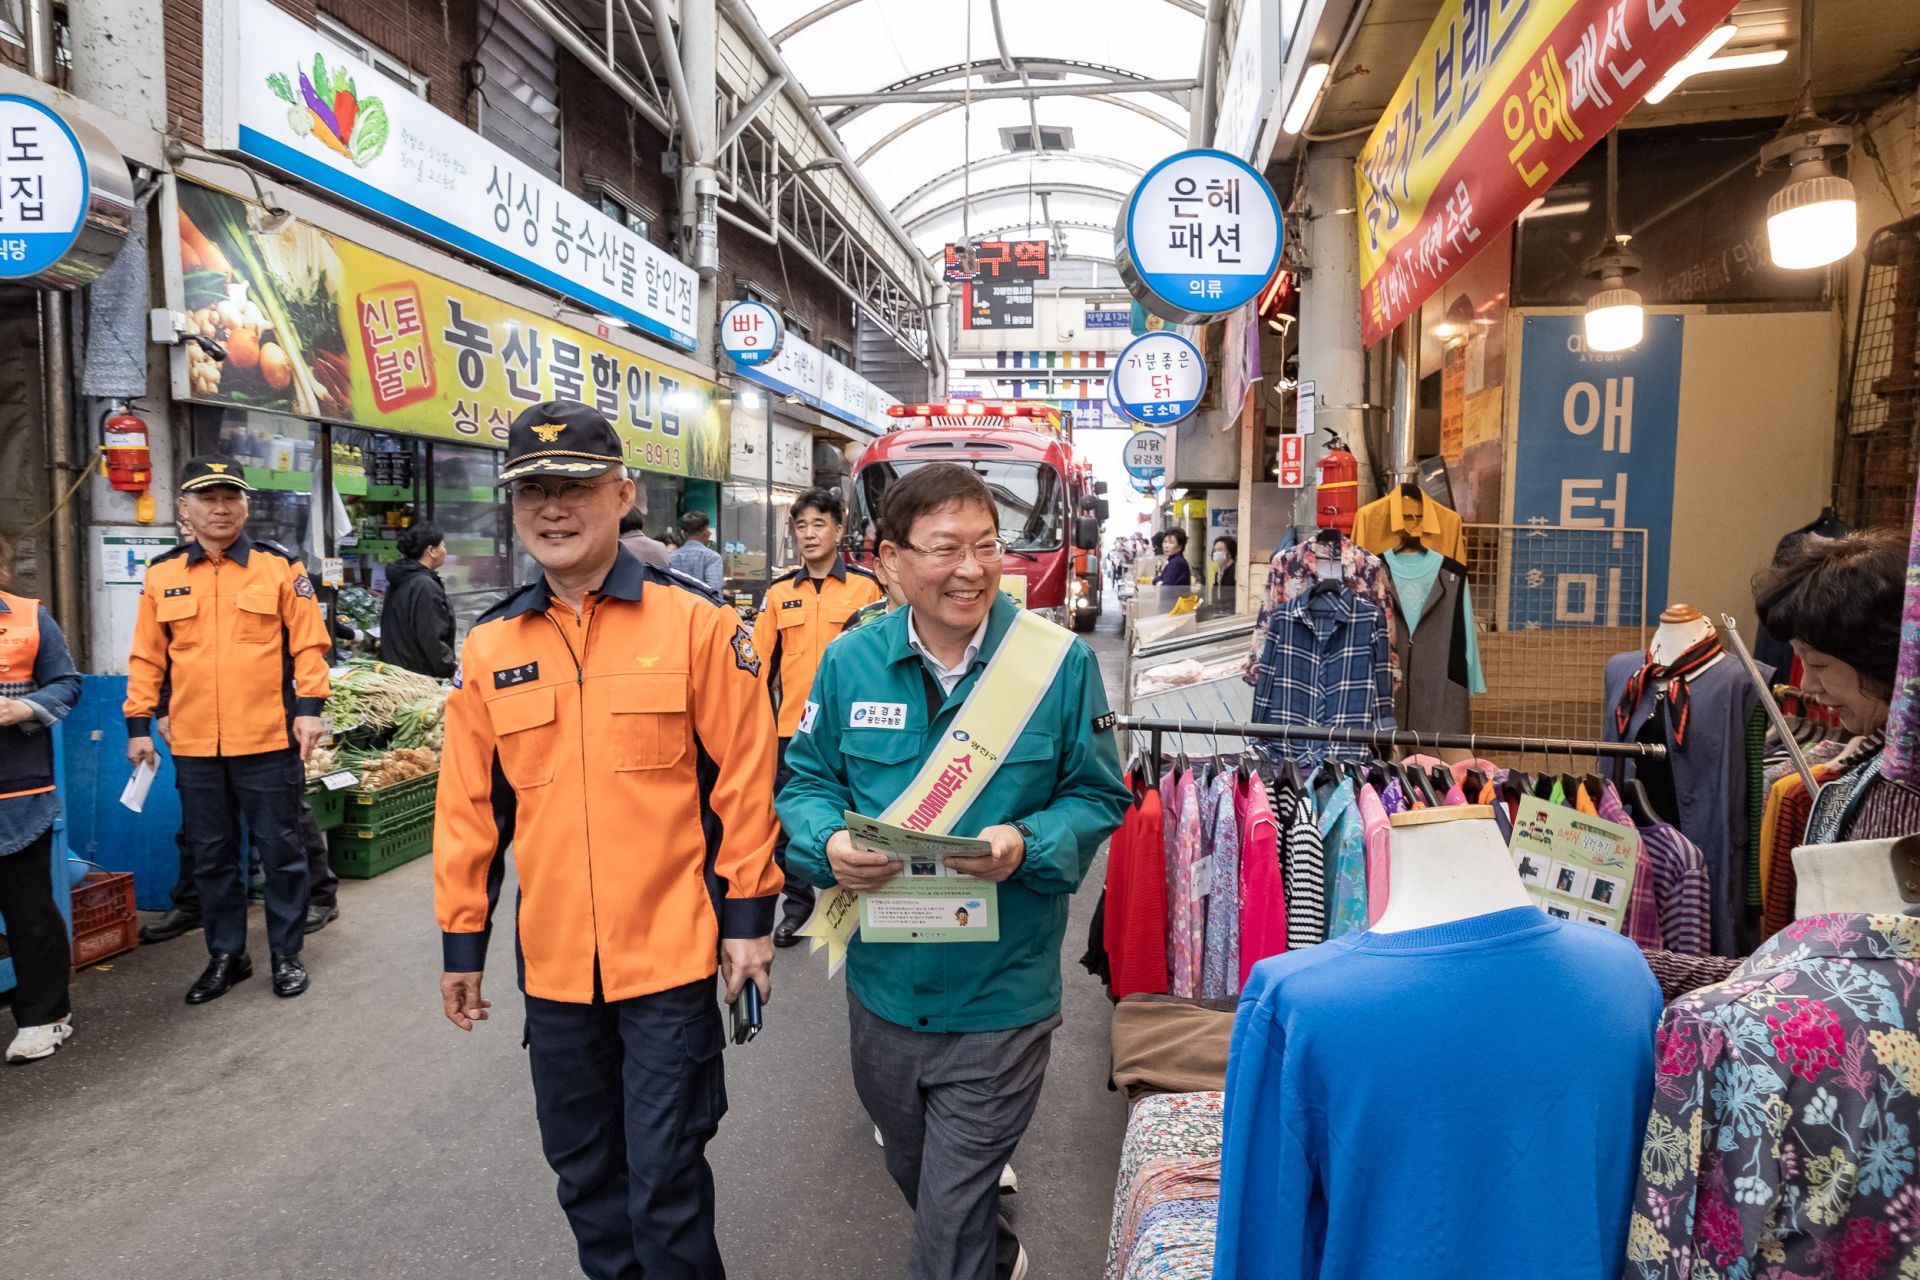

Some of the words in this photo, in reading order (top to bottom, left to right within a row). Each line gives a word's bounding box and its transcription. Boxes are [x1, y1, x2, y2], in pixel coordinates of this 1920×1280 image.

[1168, 177, 1240, 219] 은혜
[485, 164, 540, 248] 싱싱
[551, 200, 638, 299] 농수산물
[644, 255, 693, 326] 할인점
[1168, 223, 1241, 264] 패션
[1189, 279, 1223, 299] 의류
[732, 313, 764, 347] 빵
[444, 296, 682, 438] 농산물할인점
[1151, 375, 1173, 399] 닭
[1555, 375, 1634, 629] 애터미
[971, 740, 998, 761] 광진구
